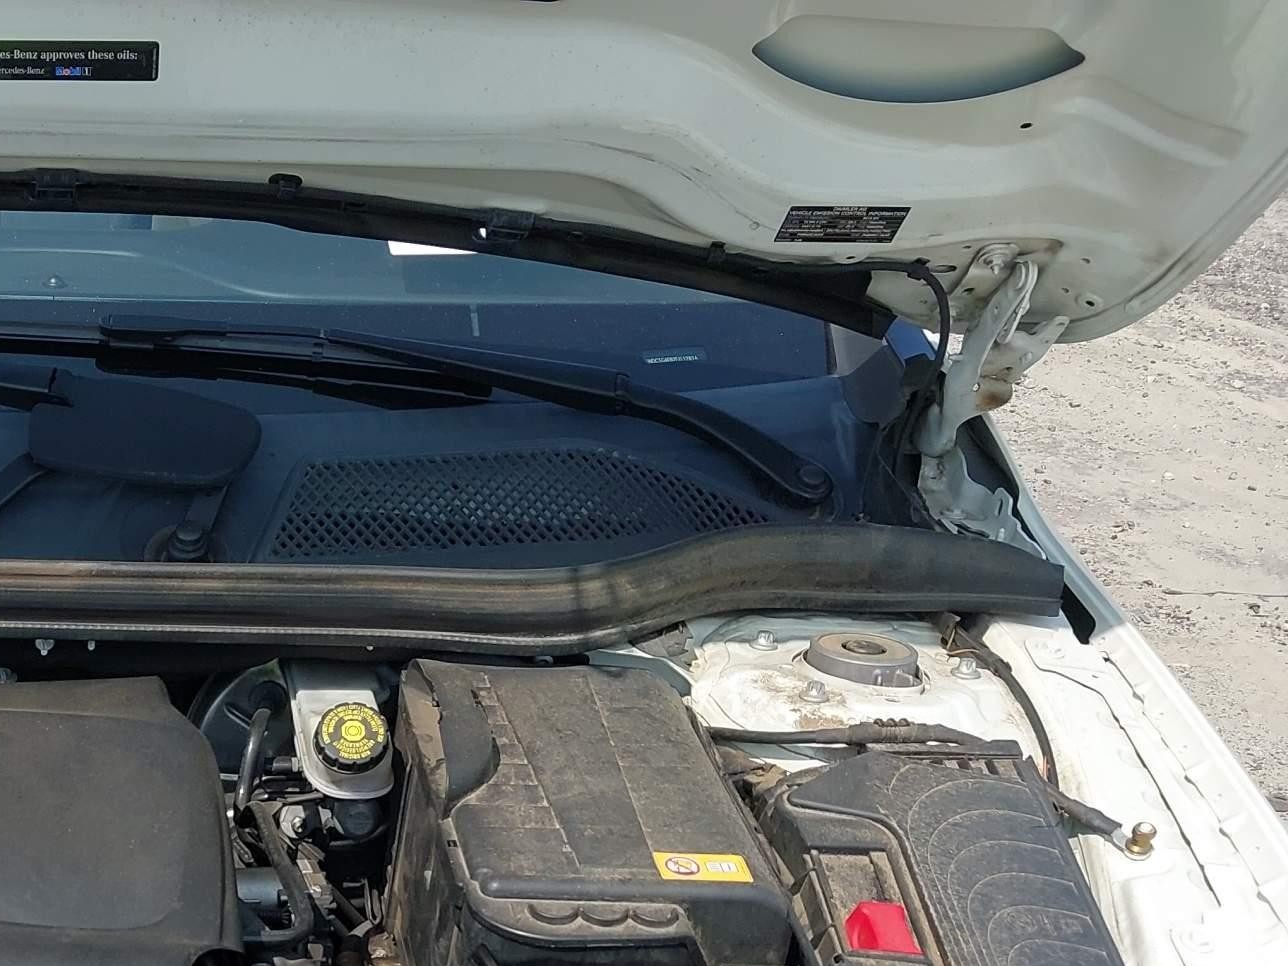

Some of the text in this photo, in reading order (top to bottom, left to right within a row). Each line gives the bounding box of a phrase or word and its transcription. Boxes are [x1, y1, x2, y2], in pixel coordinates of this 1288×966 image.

[40, 50, 86, 62] approves
[88, 49, 115, 60] these
[116, 49, 139, 60] oils:
